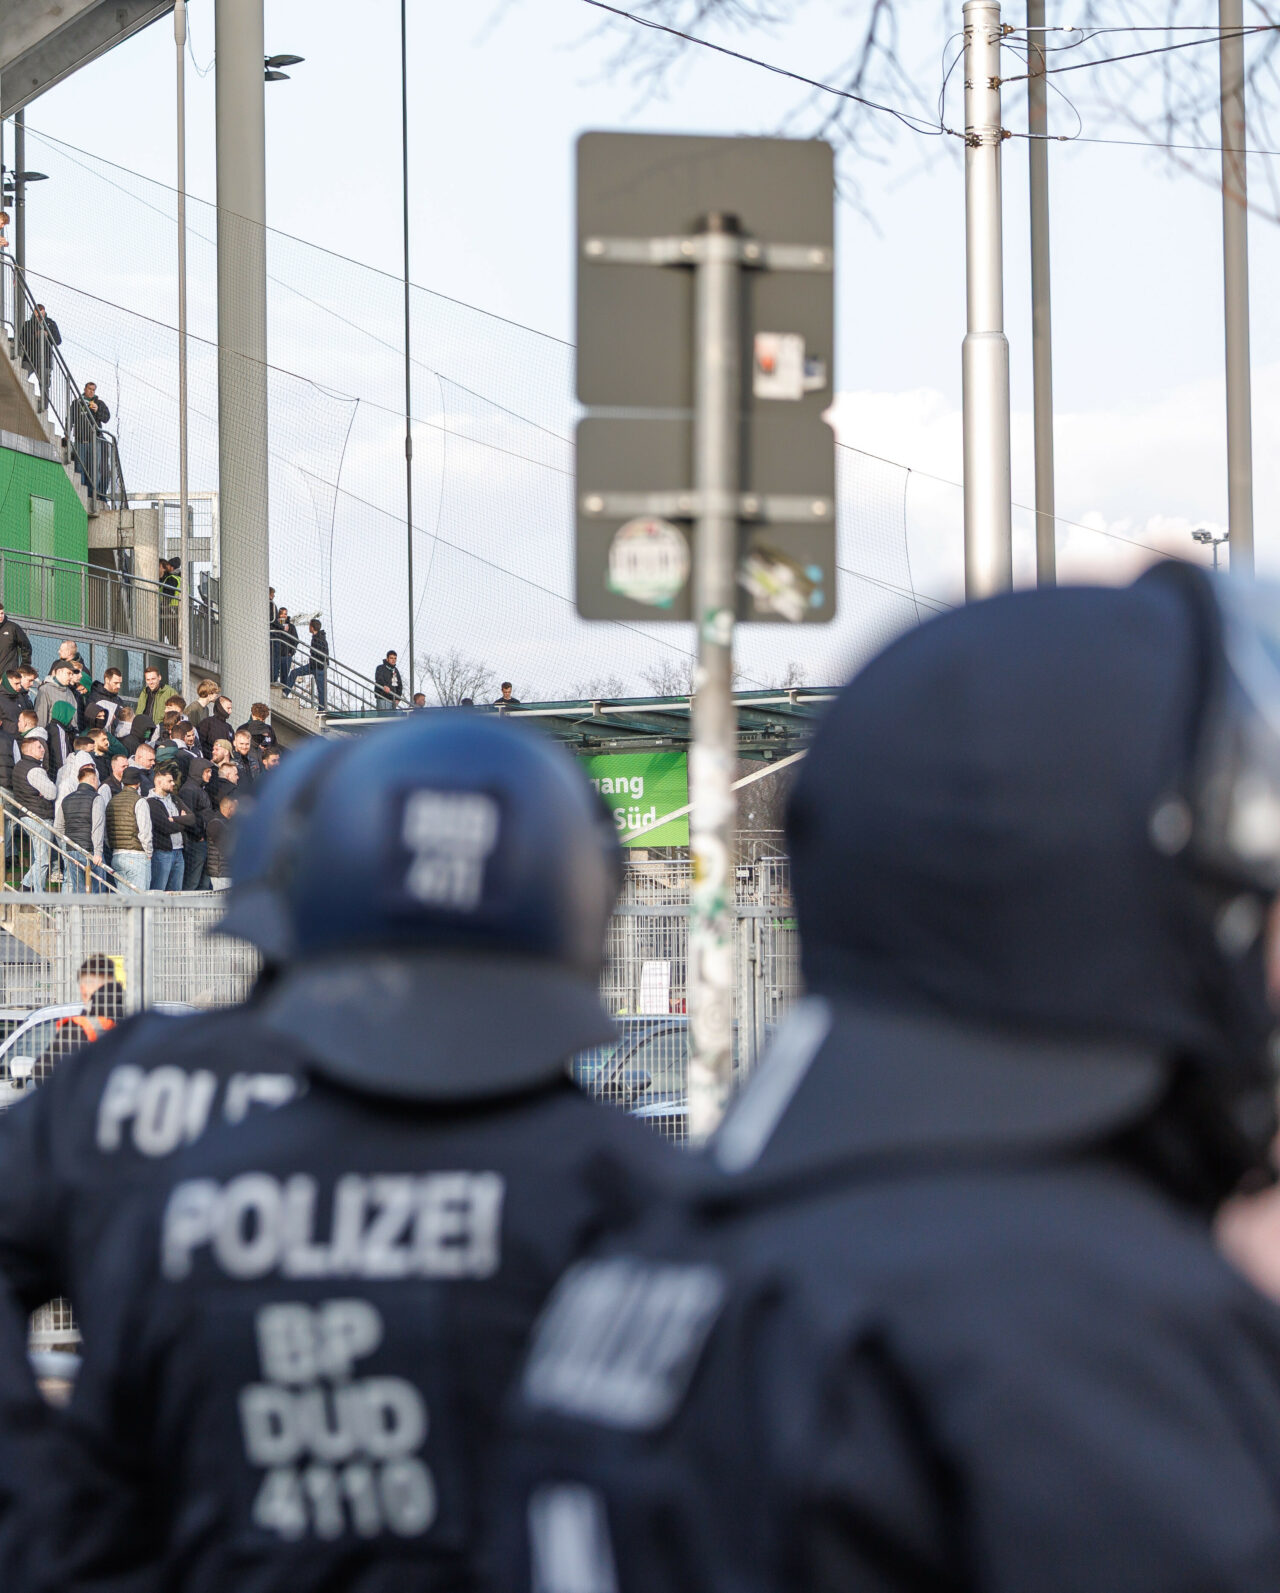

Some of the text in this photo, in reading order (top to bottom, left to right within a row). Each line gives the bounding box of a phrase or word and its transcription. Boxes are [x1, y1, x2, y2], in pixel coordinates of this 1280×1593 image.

[613, 806, 656, 830] Süd
[160, 1170, 506, 1282] POLIZEI
[255, 1298, 383, 1384] BP
[238, 1375, 428, 1468] DUD
[252, 1457, 437, 1541] 4110
